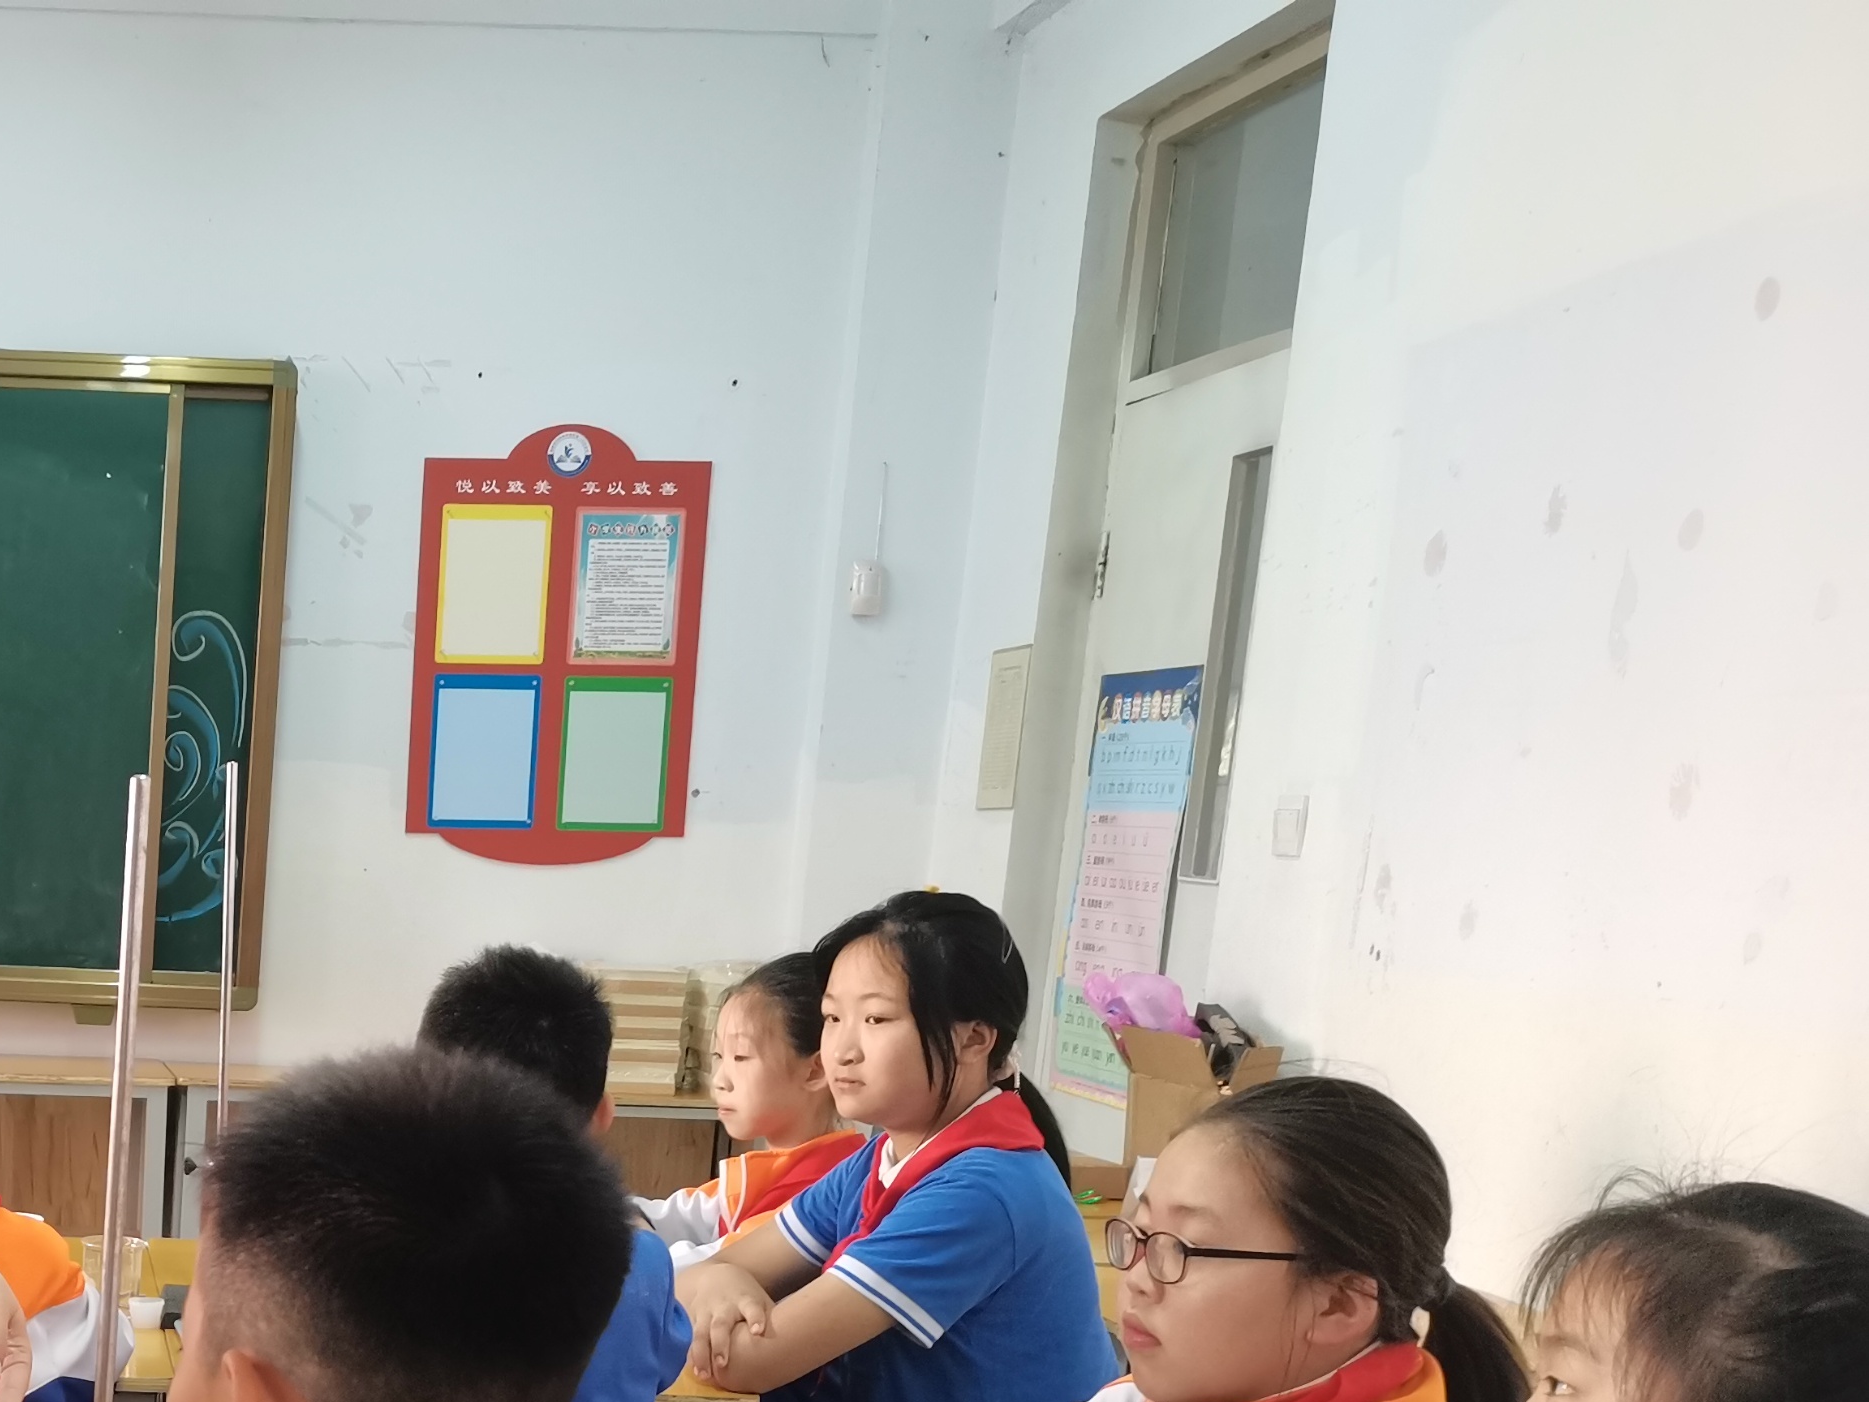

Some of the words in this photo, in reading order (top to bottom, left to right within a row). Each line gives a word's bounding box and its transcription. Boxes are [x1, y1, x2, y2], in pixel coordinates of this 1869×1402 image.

[455, 480, 552, 495] 悦以致美
[581, 481, 679, 496] 享以致善
[1111, 693, 1185, 720] 汉语拼音字母表
